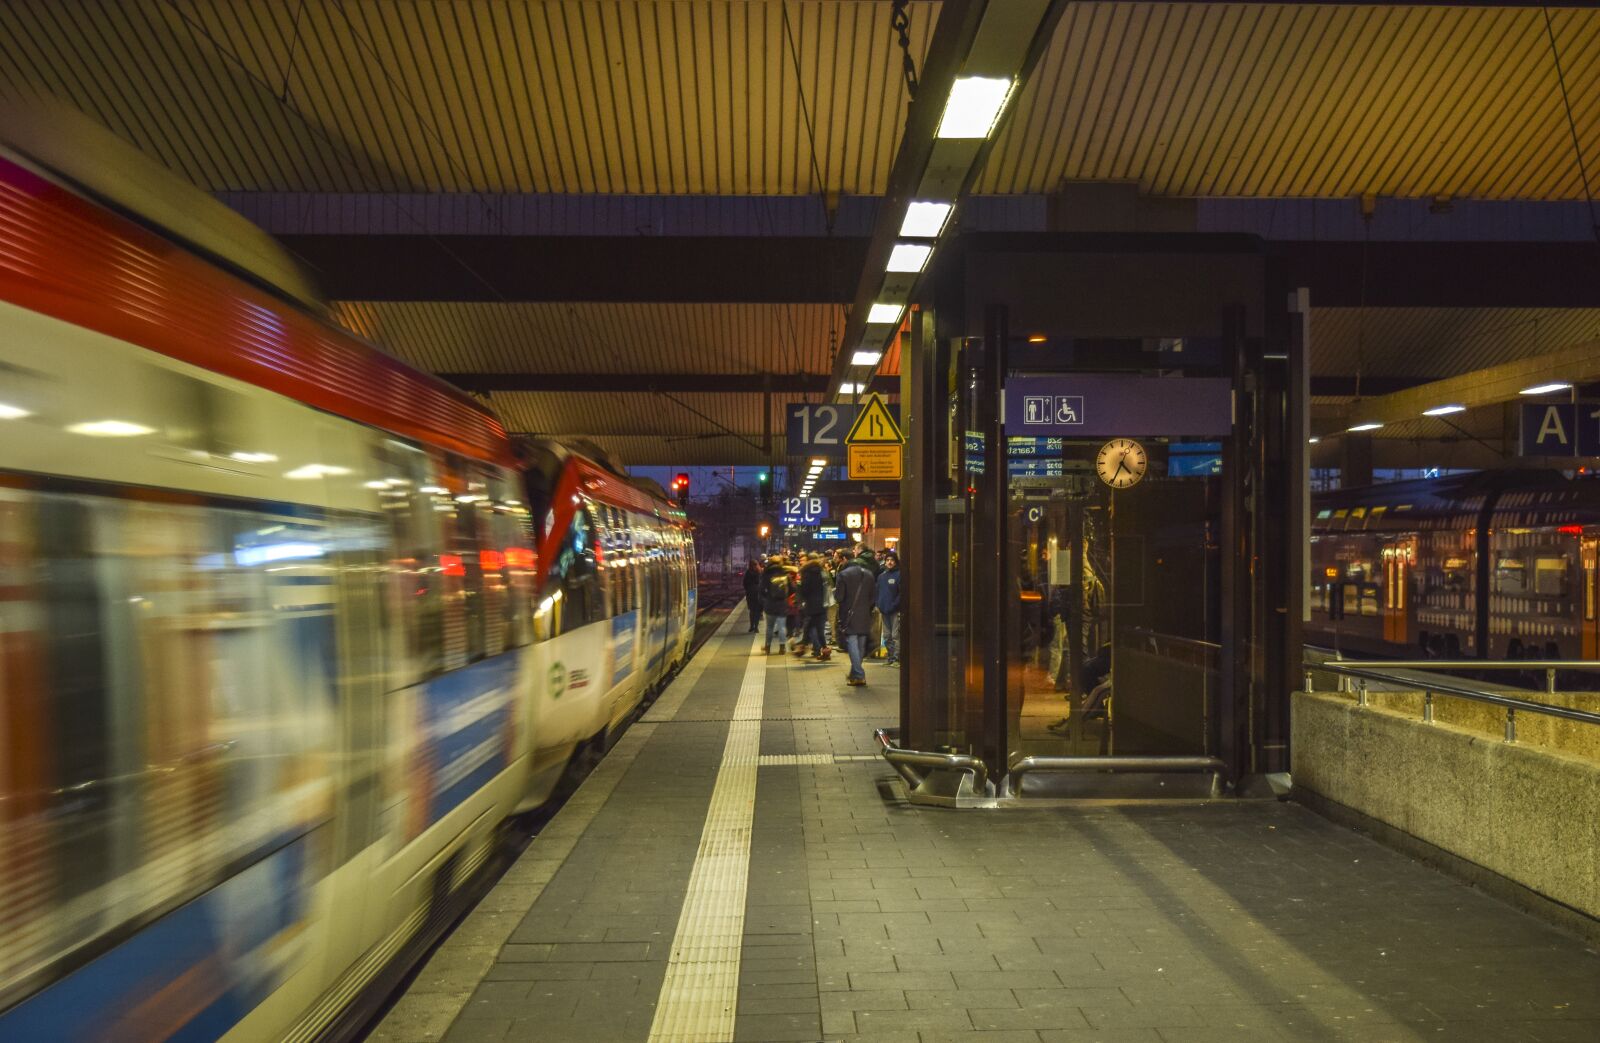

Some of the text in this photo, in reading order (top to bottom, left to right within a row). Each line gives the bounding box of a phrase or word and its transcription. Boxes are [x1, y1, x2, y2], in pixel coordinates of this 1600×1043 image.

[794, 406, 838, 444] 12
[1536, 406, 1567, 444] A
[782, 497, 822, 514] 12 B
[1029, 507, 1039, 522] C
